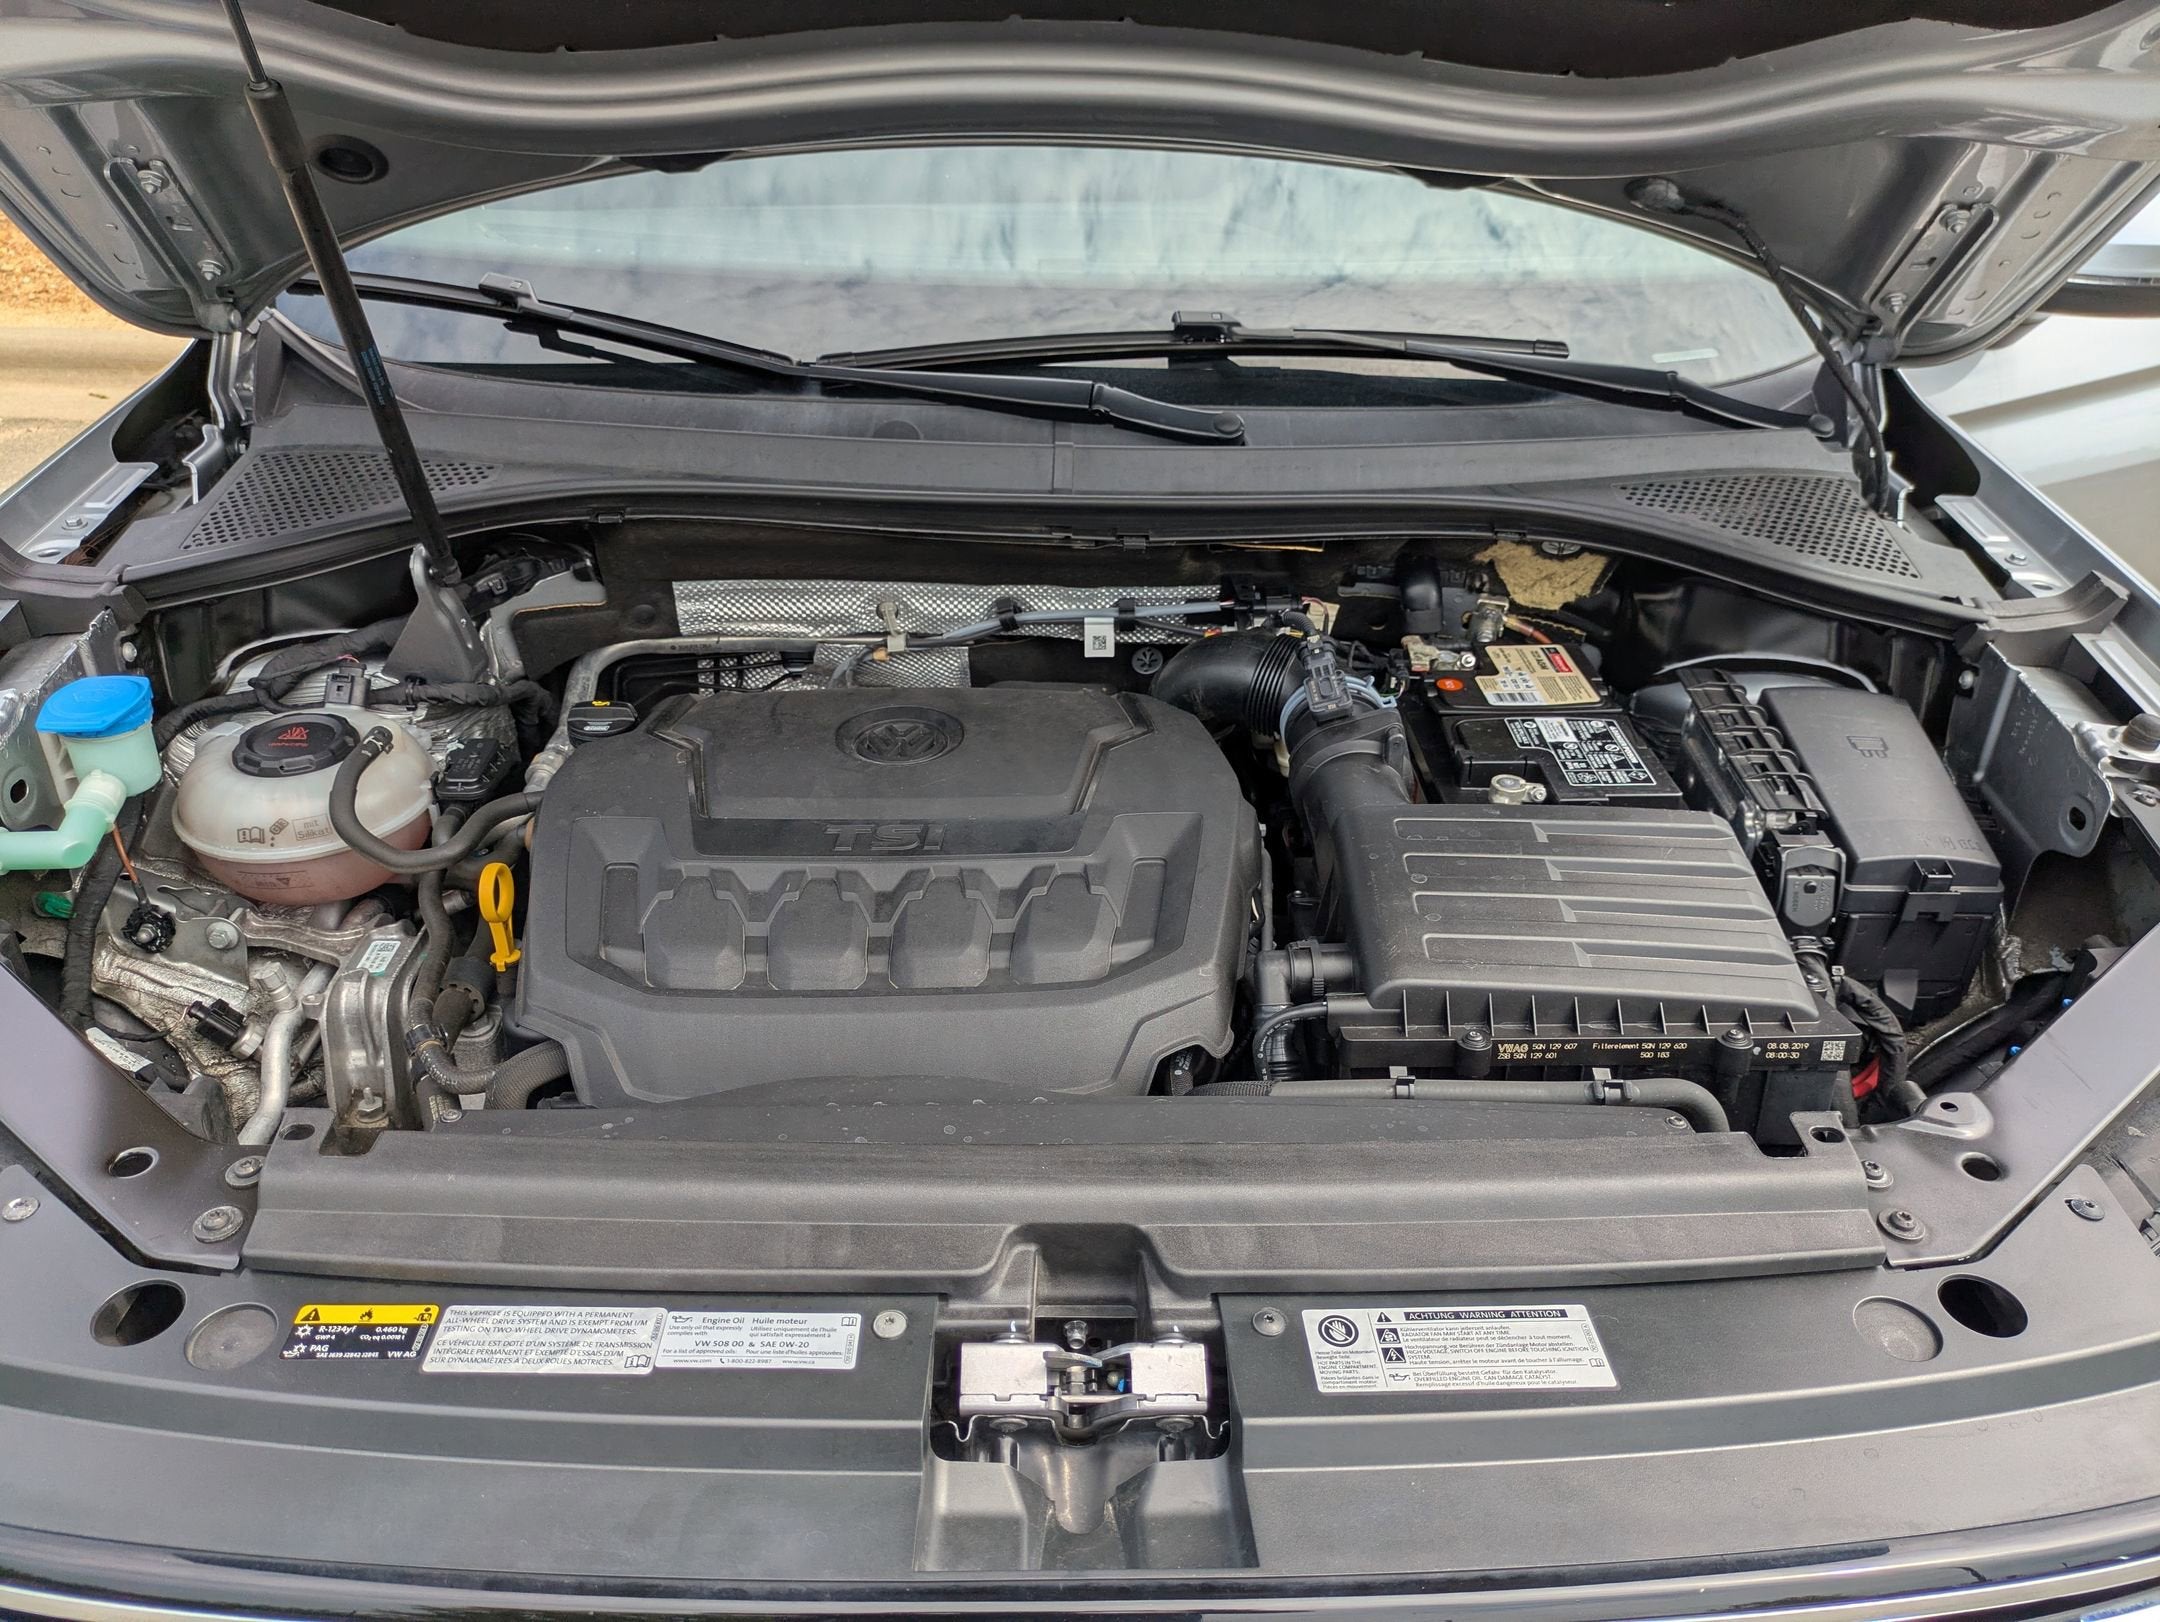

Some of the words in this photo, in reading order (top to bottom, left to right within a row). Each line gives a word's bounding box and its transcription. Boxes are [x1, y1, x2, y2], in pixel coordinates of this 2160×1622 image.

[824, 824, 946, 851] TSI
[1498, 1044, 1528, 1053] VWAG
[1409, 1312, 1455, 1320] ACHTUNG
[702, 1317, 731, 1325] Engine
[319, 1325, 357, 1334] R-1234yf
[398, 1326, 408, 1334] kg
